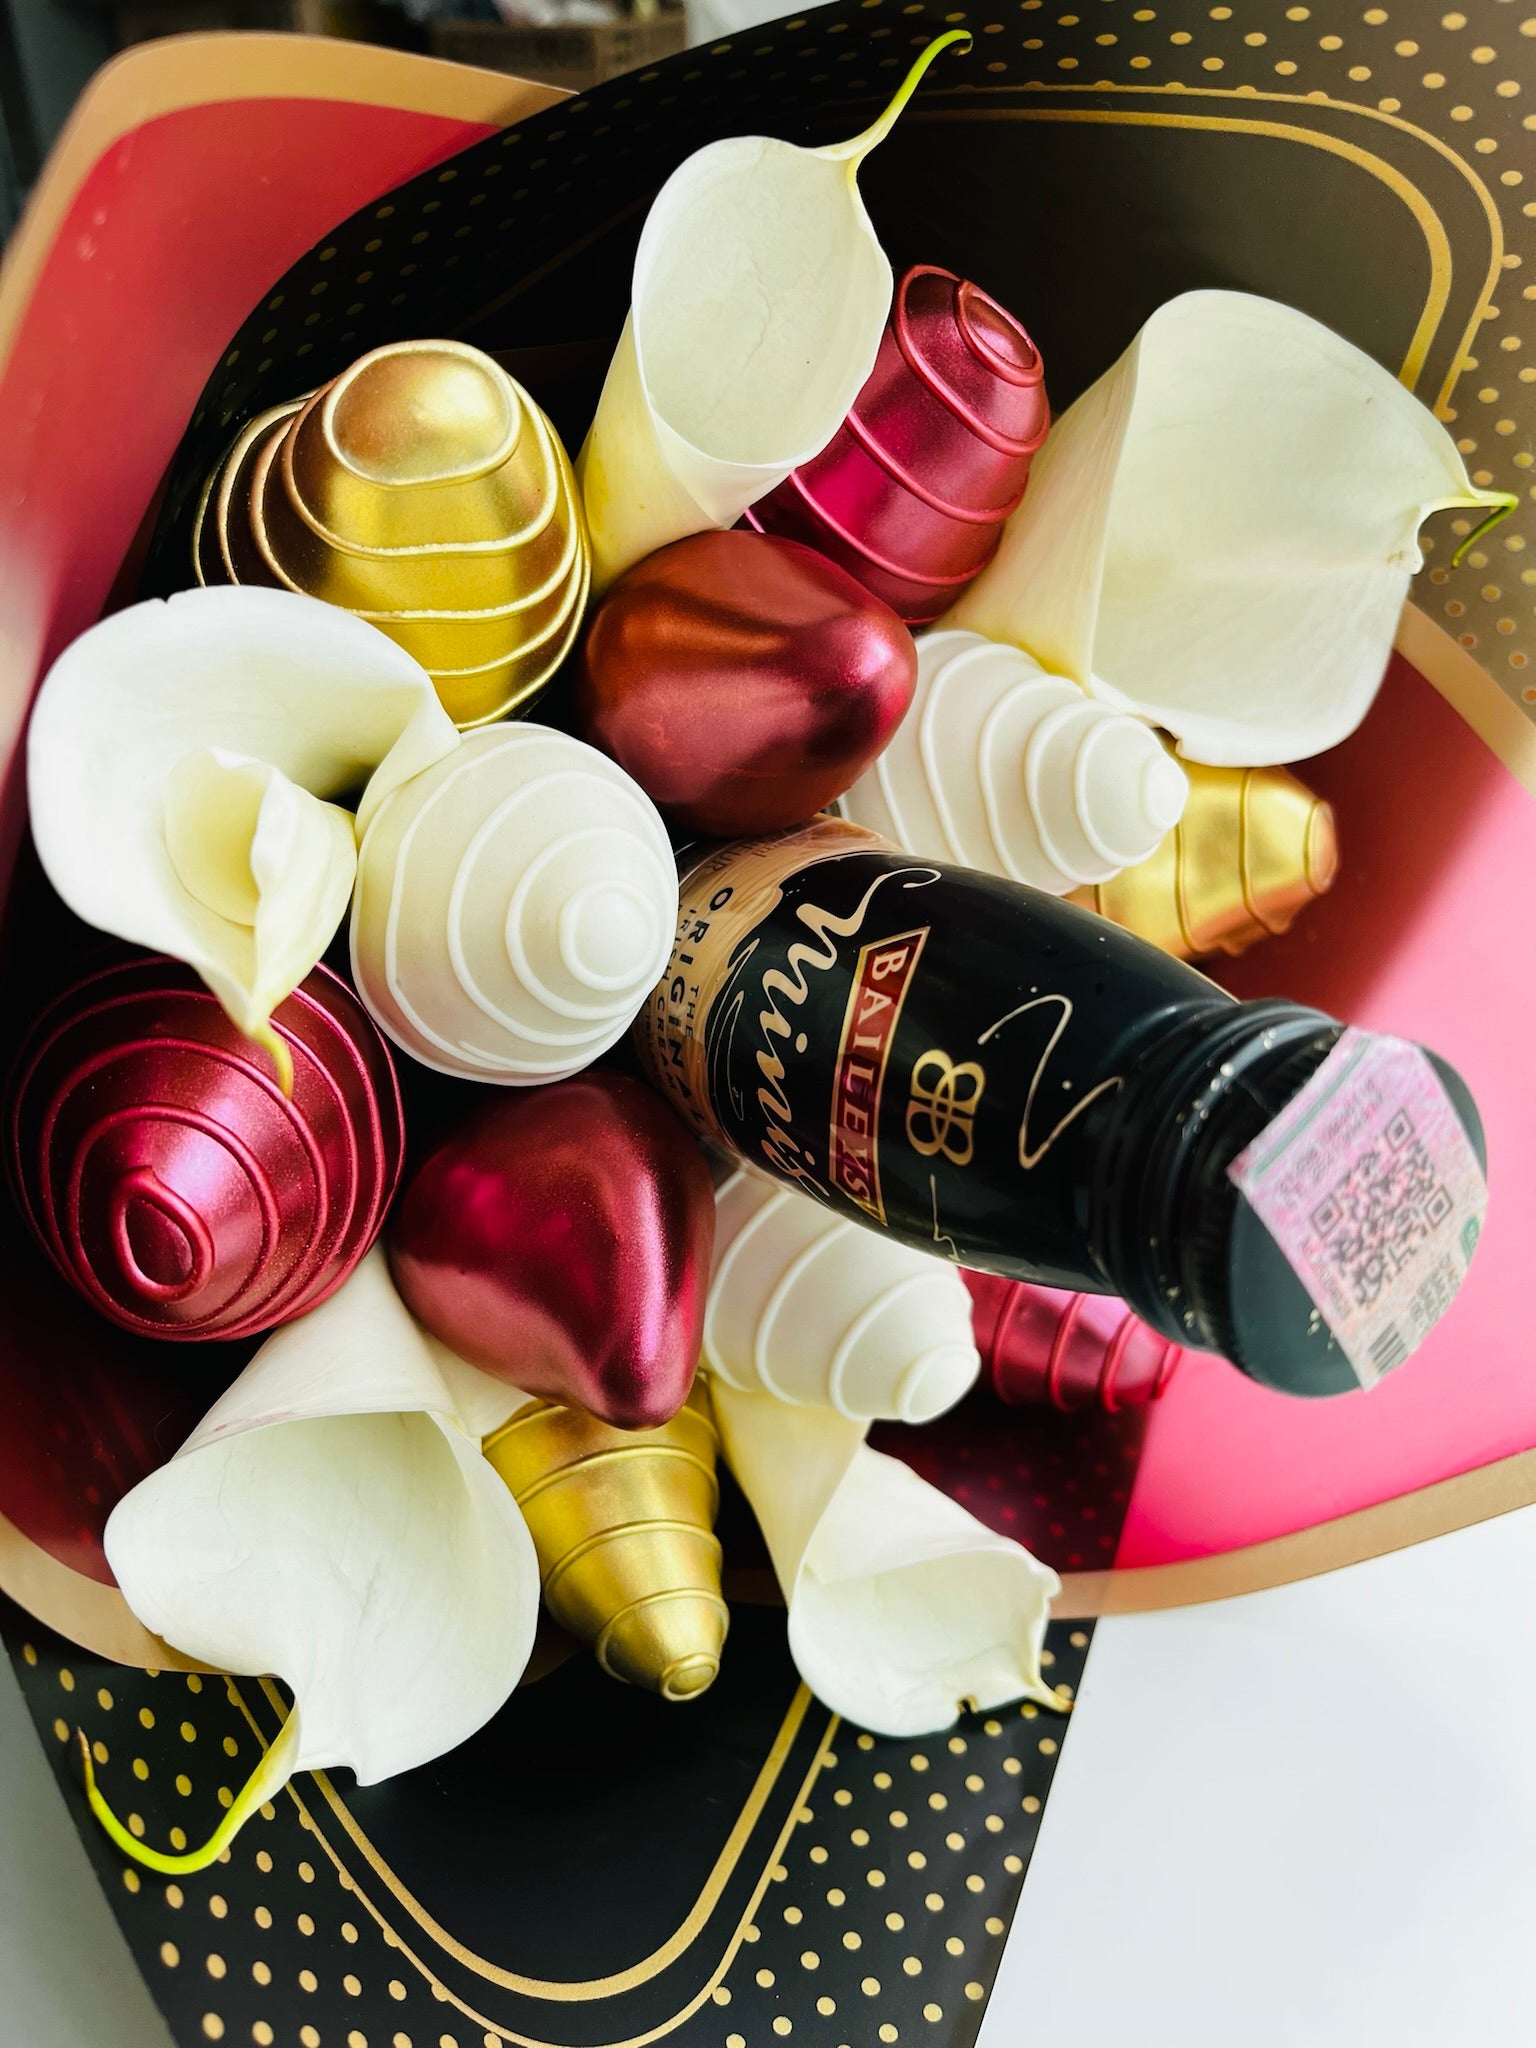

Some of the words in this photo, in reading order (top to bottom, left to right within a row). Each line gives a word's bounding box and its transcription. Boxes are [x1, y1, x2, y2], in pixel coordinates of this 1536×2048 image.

[656, 996, 677, 1089] CREAM
[668, 886, 734, 1122] ORIGINAL
[685, 984, 700, 1040] THE
[842, 945, 910, 1201] BAILEYS
